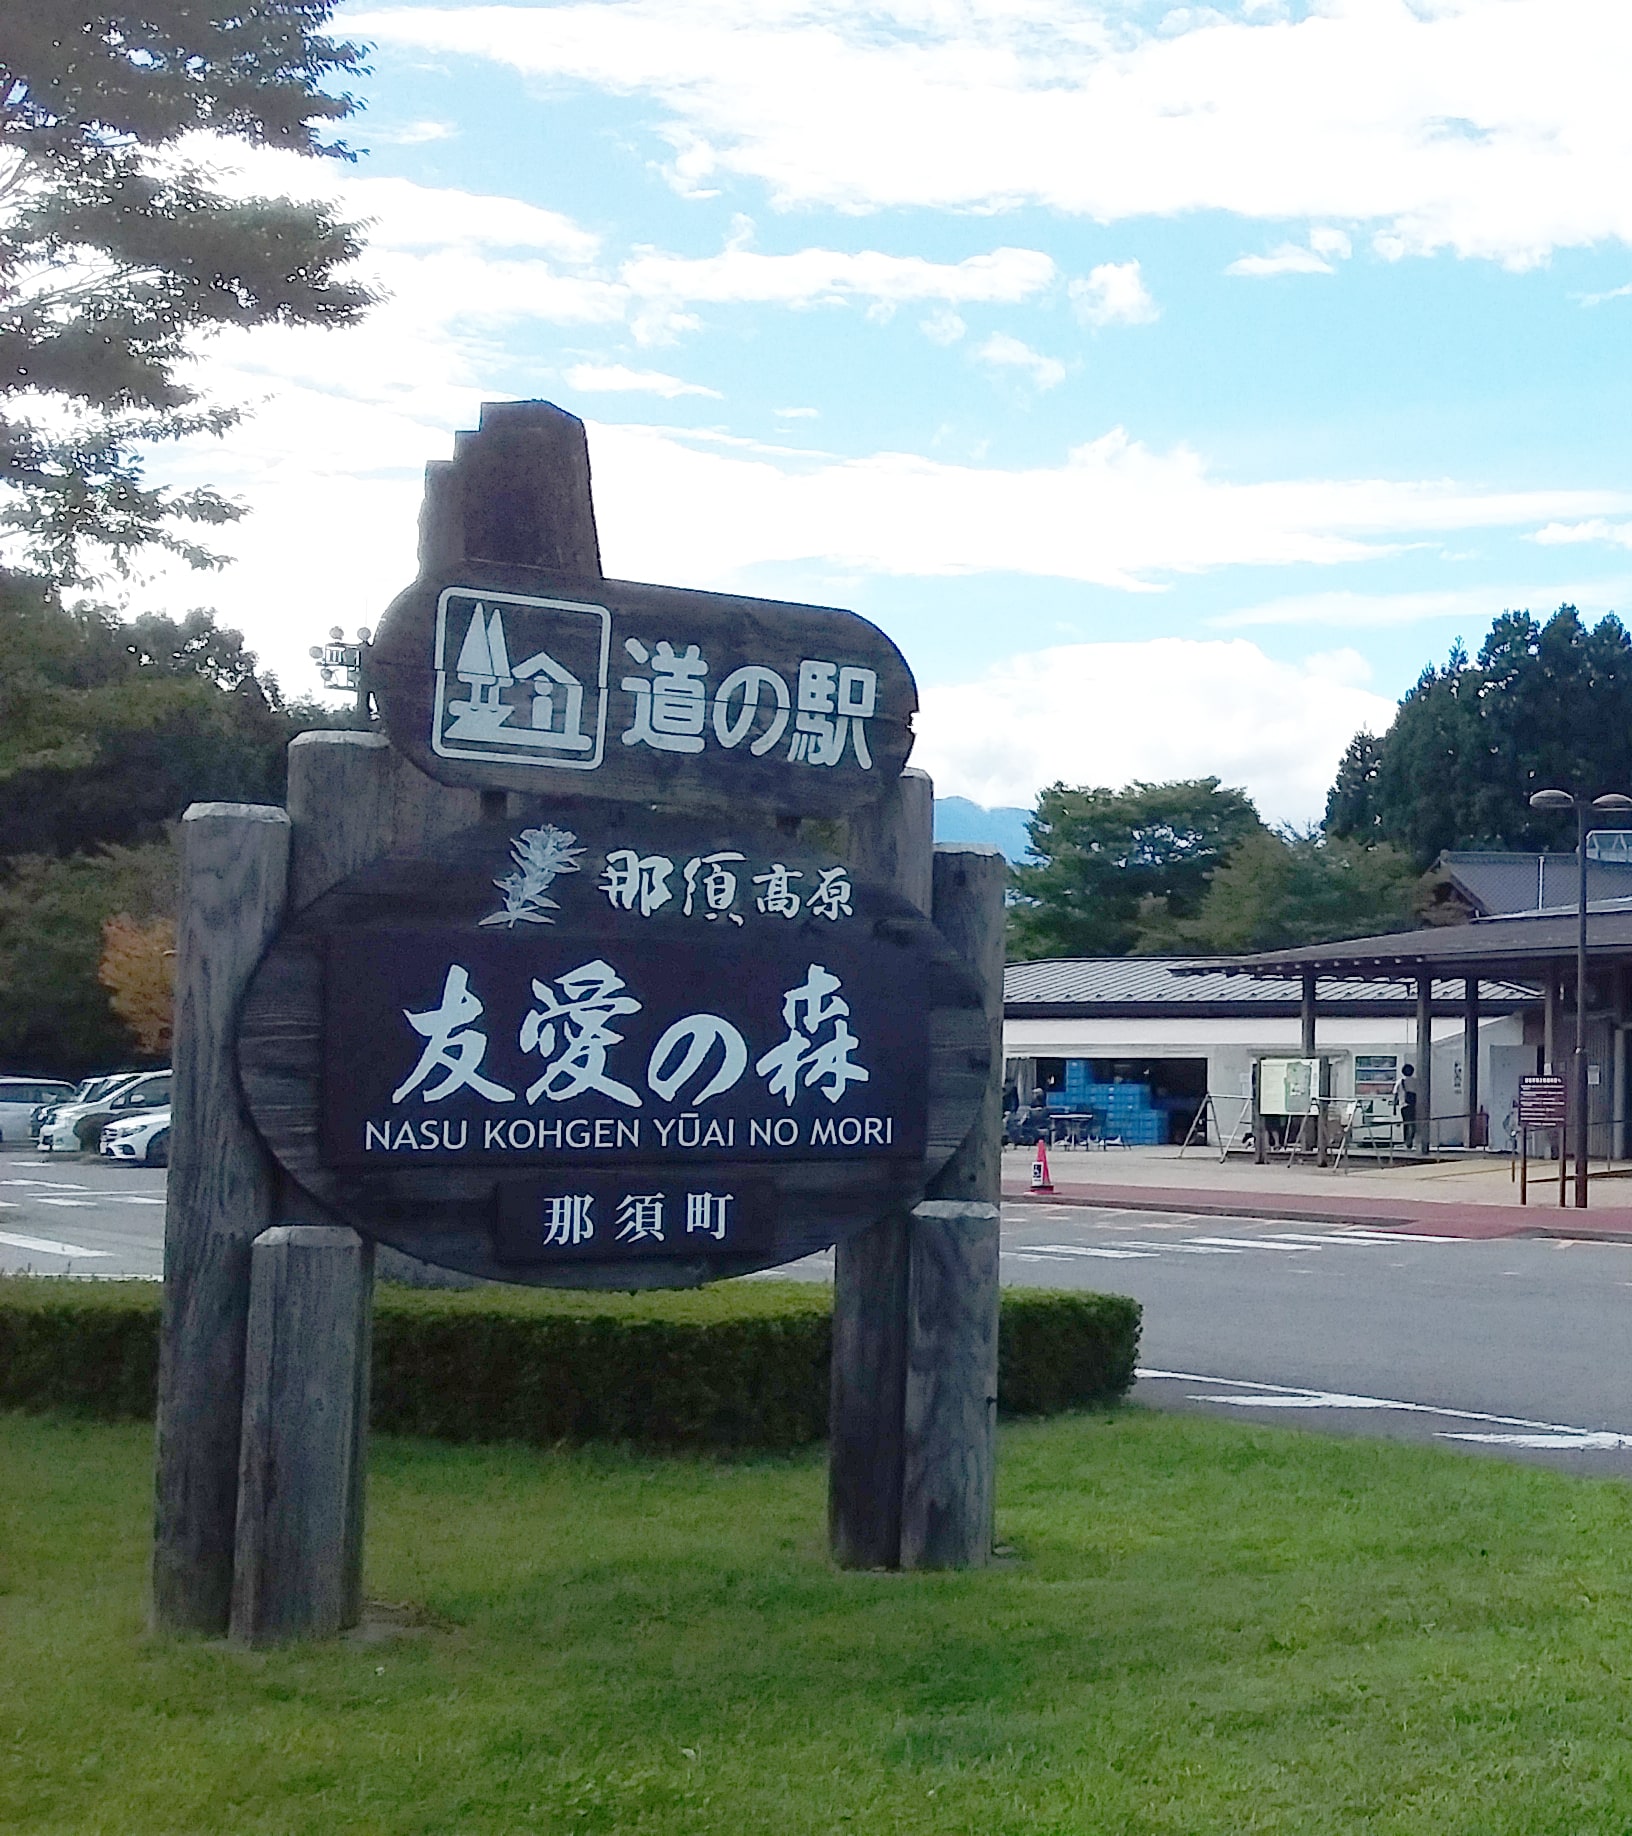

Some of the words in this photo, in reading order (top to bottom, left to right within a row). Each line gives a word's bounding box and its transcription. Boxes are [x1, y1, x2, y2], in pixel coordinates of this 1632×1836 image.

[621, 638, 879, 770] 道の駅
[598, 850, 853, 927] 那須高原
[393, 960, 870, 1108] 友愛の森
[365, 1120, 467, 1150] NASU
[485, 1118, 640, 1149] KOHGEN
[653, 1113, 735, 1147] YŪAI
[750, 1118, 799, 1146] NO
[810, 1117, 892, 1146] MORI
[543, 1192, 735, 1246] 那須町
